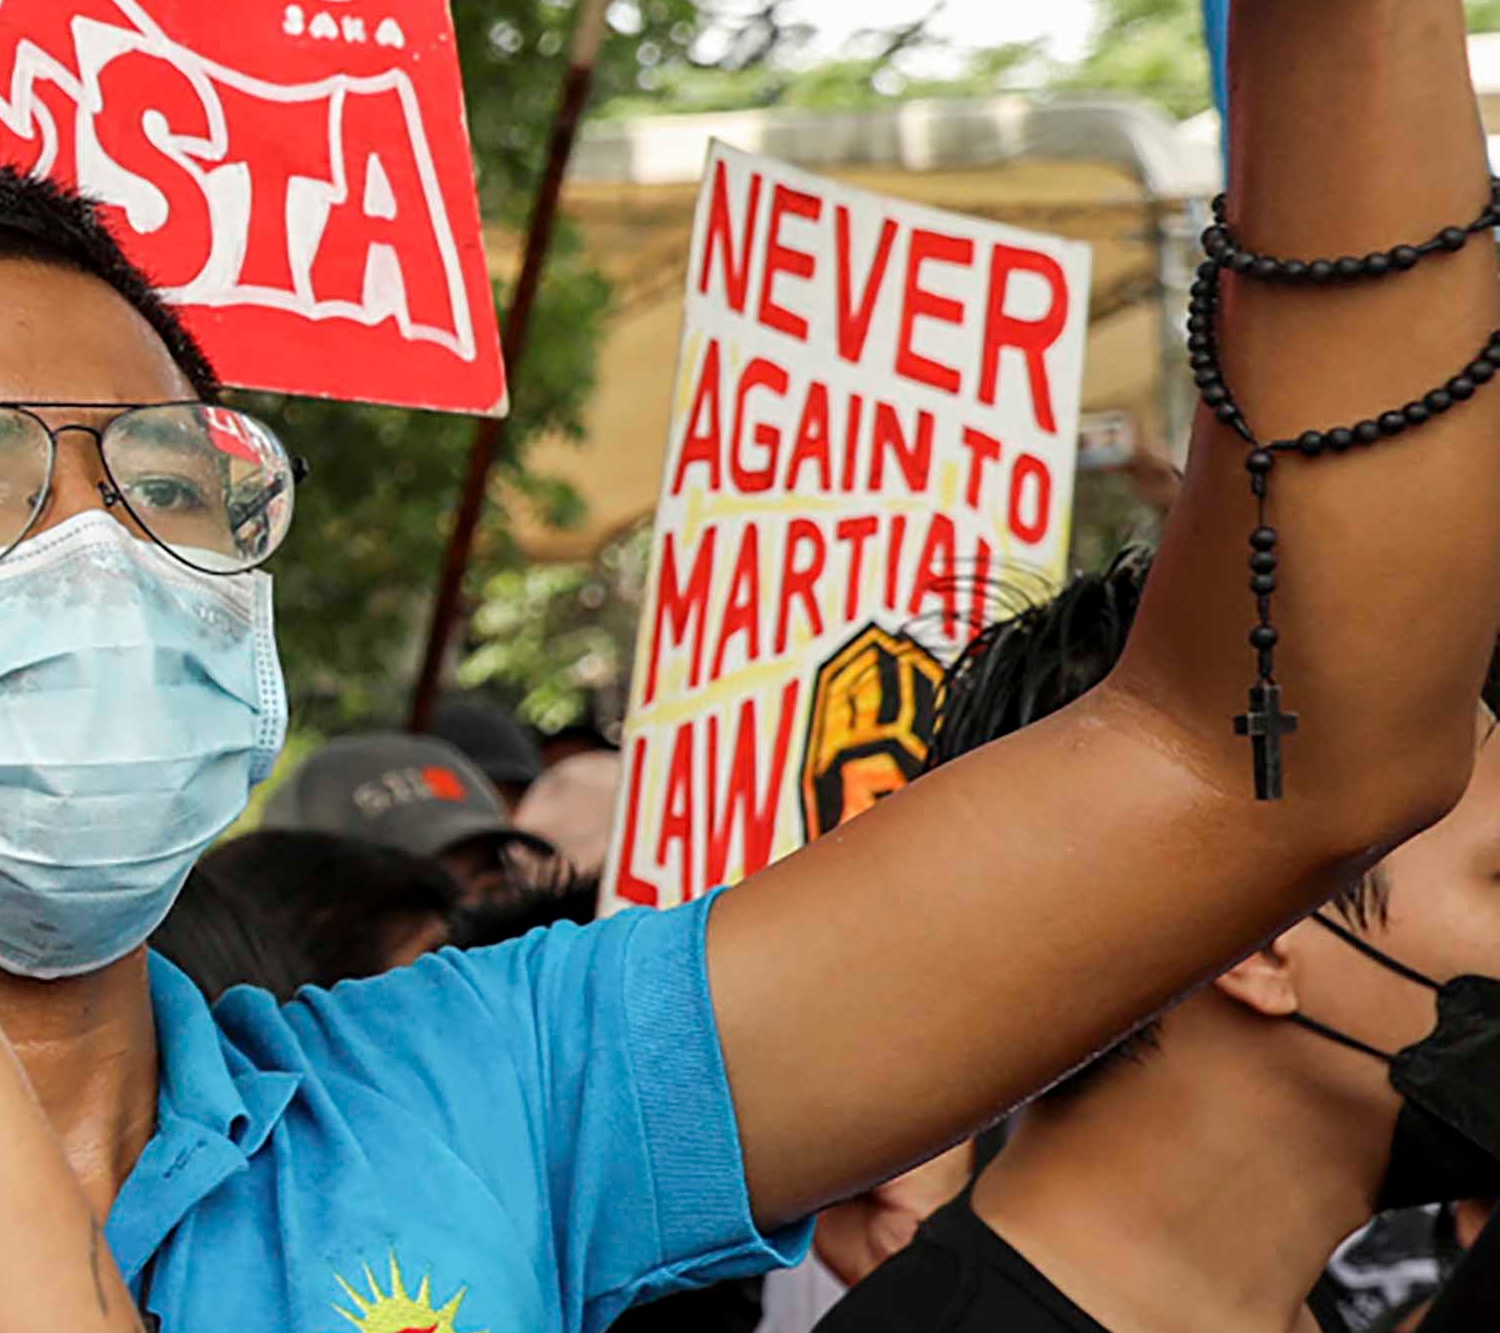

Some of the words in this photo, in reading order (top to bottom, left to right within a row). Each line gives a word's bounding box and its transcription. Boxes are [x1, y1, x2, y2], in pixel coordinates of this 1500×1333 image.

[700, 158, 1069, 435] NEVER
[672, 340, 935, 496] AGAIN
[957, 426, 1052, 545] TO
[616, 679, 799, 908] LAW
